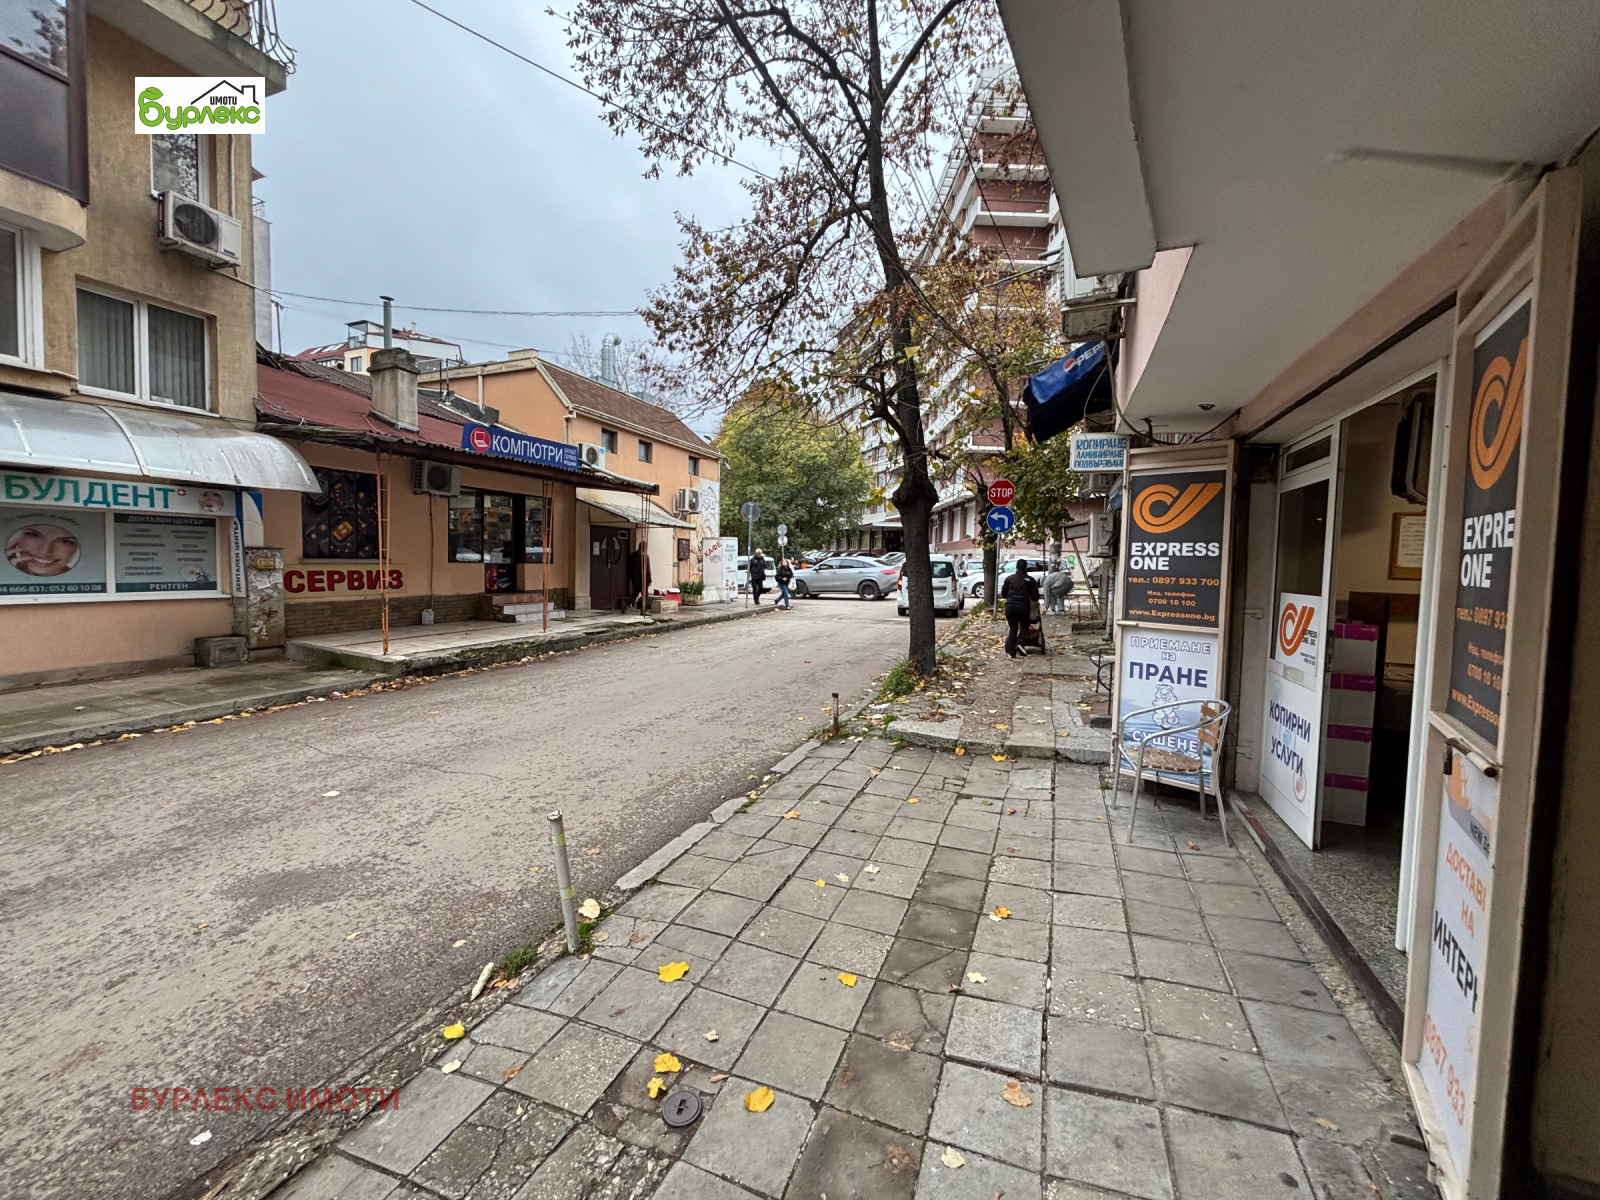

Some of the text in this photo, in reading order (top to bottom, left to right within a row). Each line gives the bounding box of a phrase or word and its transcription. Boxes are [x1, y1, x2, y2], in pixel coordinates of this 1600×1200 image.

[492, 434, 563, 463] КОМПЮТРИ
[1076, 438, 1127, 450] КОПИРАНЕ
[1076, 450, 1124, 459] ЛАМИНИРАНЕ
[4, 474, 175, 509] БУЛДЕНТ
[990, 488, 1013, 498] STOP
[1463, 509, 1516, 550] EXPRE
[704, 540, 723, 558] КАФЕ
[1131, 542, 1220, 557] EXPRESS
[1130, 556, 1170, 571] ONE
[1461, 553, 1493, 588] ONE
[234, 553, 242, 593] ДЕНТАЛЕН
[283, 569, 403, 593] СЕРВИЗ
[1152, 576, 1176, 584] 0897
[1179, 577, 1198, 585] 933
[1200, 578, 1220, 586] 700
[1148, 597, 1167, 605] 0700
[1128, 609, 1216, 621] www.Expressone.bg
[1131, 636, 1211, 654] ПРИЕМАНЕ
[1161, 652, 1177, 662] на
[1129, 661, 1208, 688] ПРАНЕ
[1269, 700, 1311, 742] КОПИРНИ
[1271, 735, 1304, 777] УСЛУГИ
[1461, 899, 1475, 938] НА
